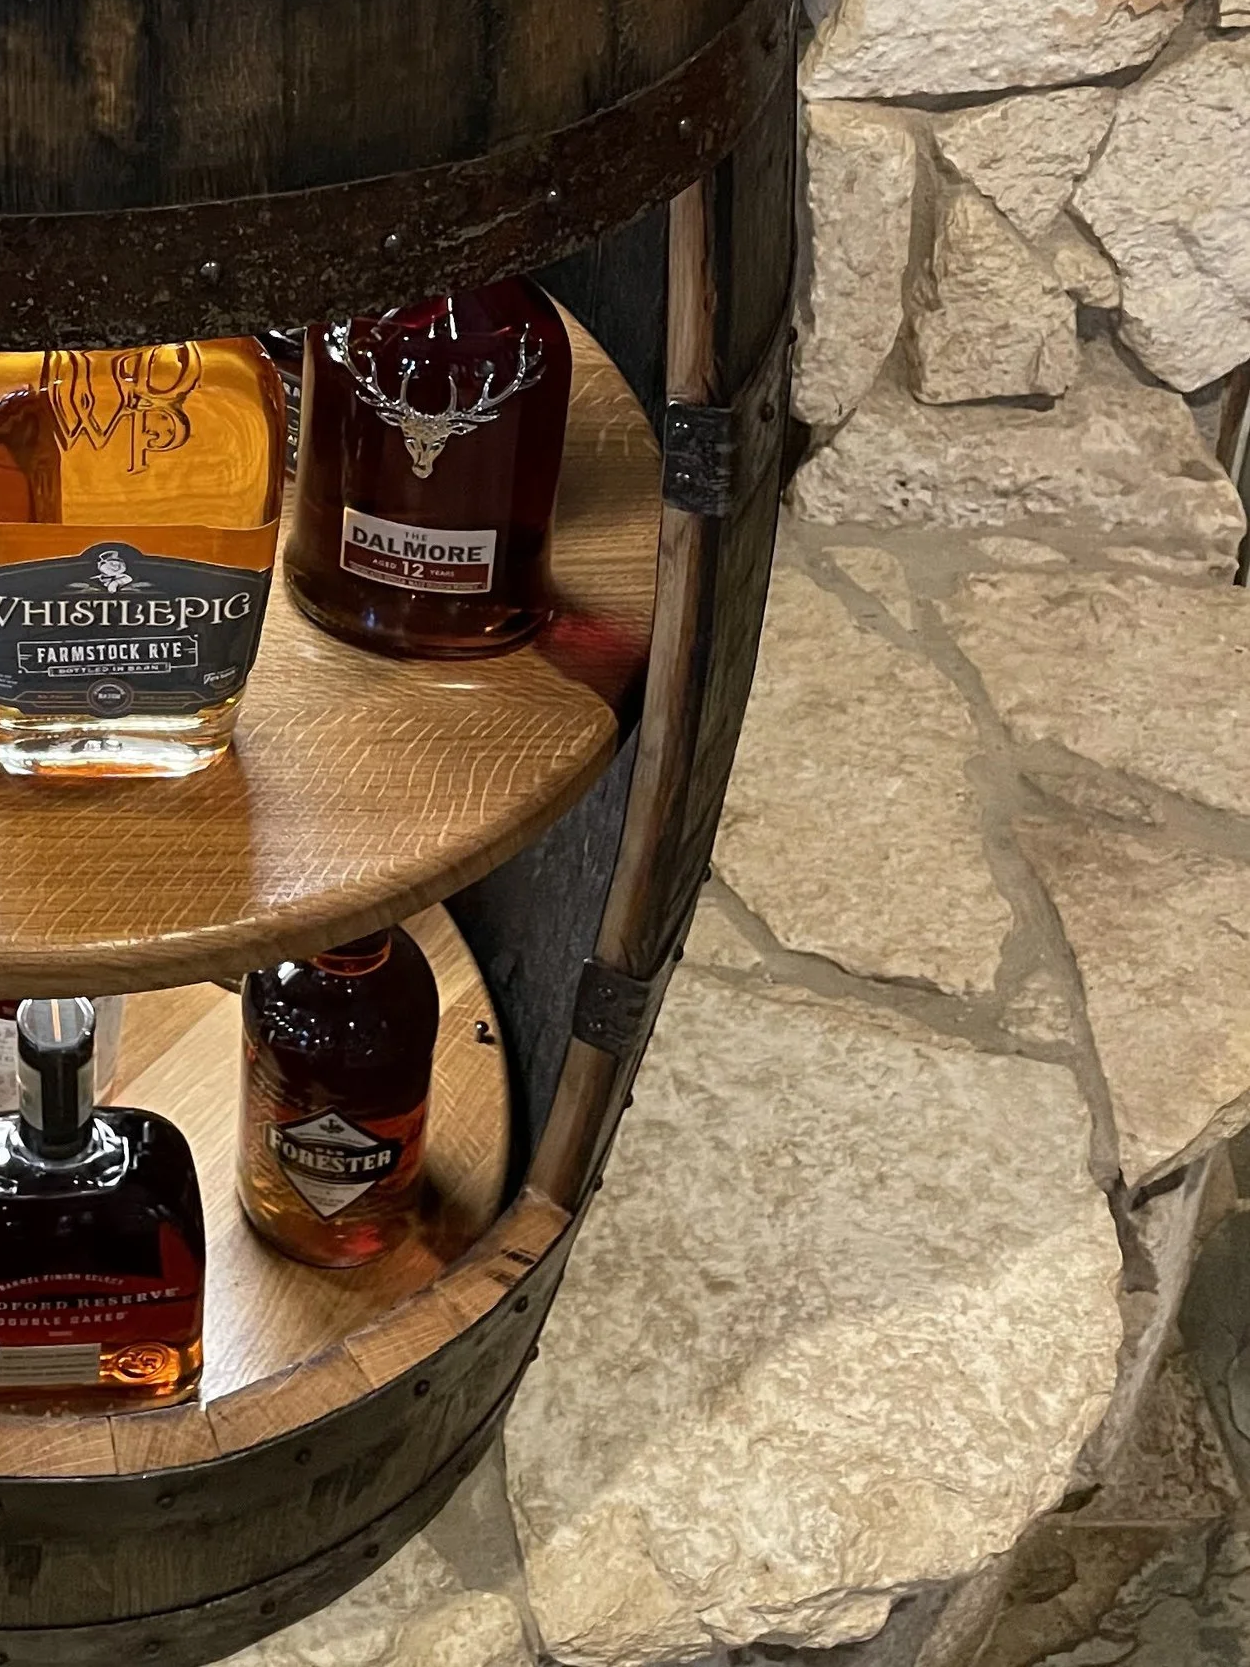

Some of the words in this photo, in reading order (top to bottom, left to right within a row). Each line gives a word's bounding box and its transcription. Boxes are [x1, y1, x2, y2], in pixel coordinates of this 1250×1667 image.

[352, 525, 483, 563] DALMORE
[405, 532, 428, 541] THE
[372, 558, 397, 570] AGED
[402, 560, 425, 578] 12
[430, 569, 455, 578] YEARS
[36, 642, 140, 664] FARMSTOCK
[149, 641, 183, 660] RYE
[57, 666, 108, 675] BOTTLED
[112, 666, 125, 674] IN
[128, 664, 160, 673] BARN
[269, 1126, 392, 1173] FORESTER
[77, 1288, 177, 1309] RESERVE
